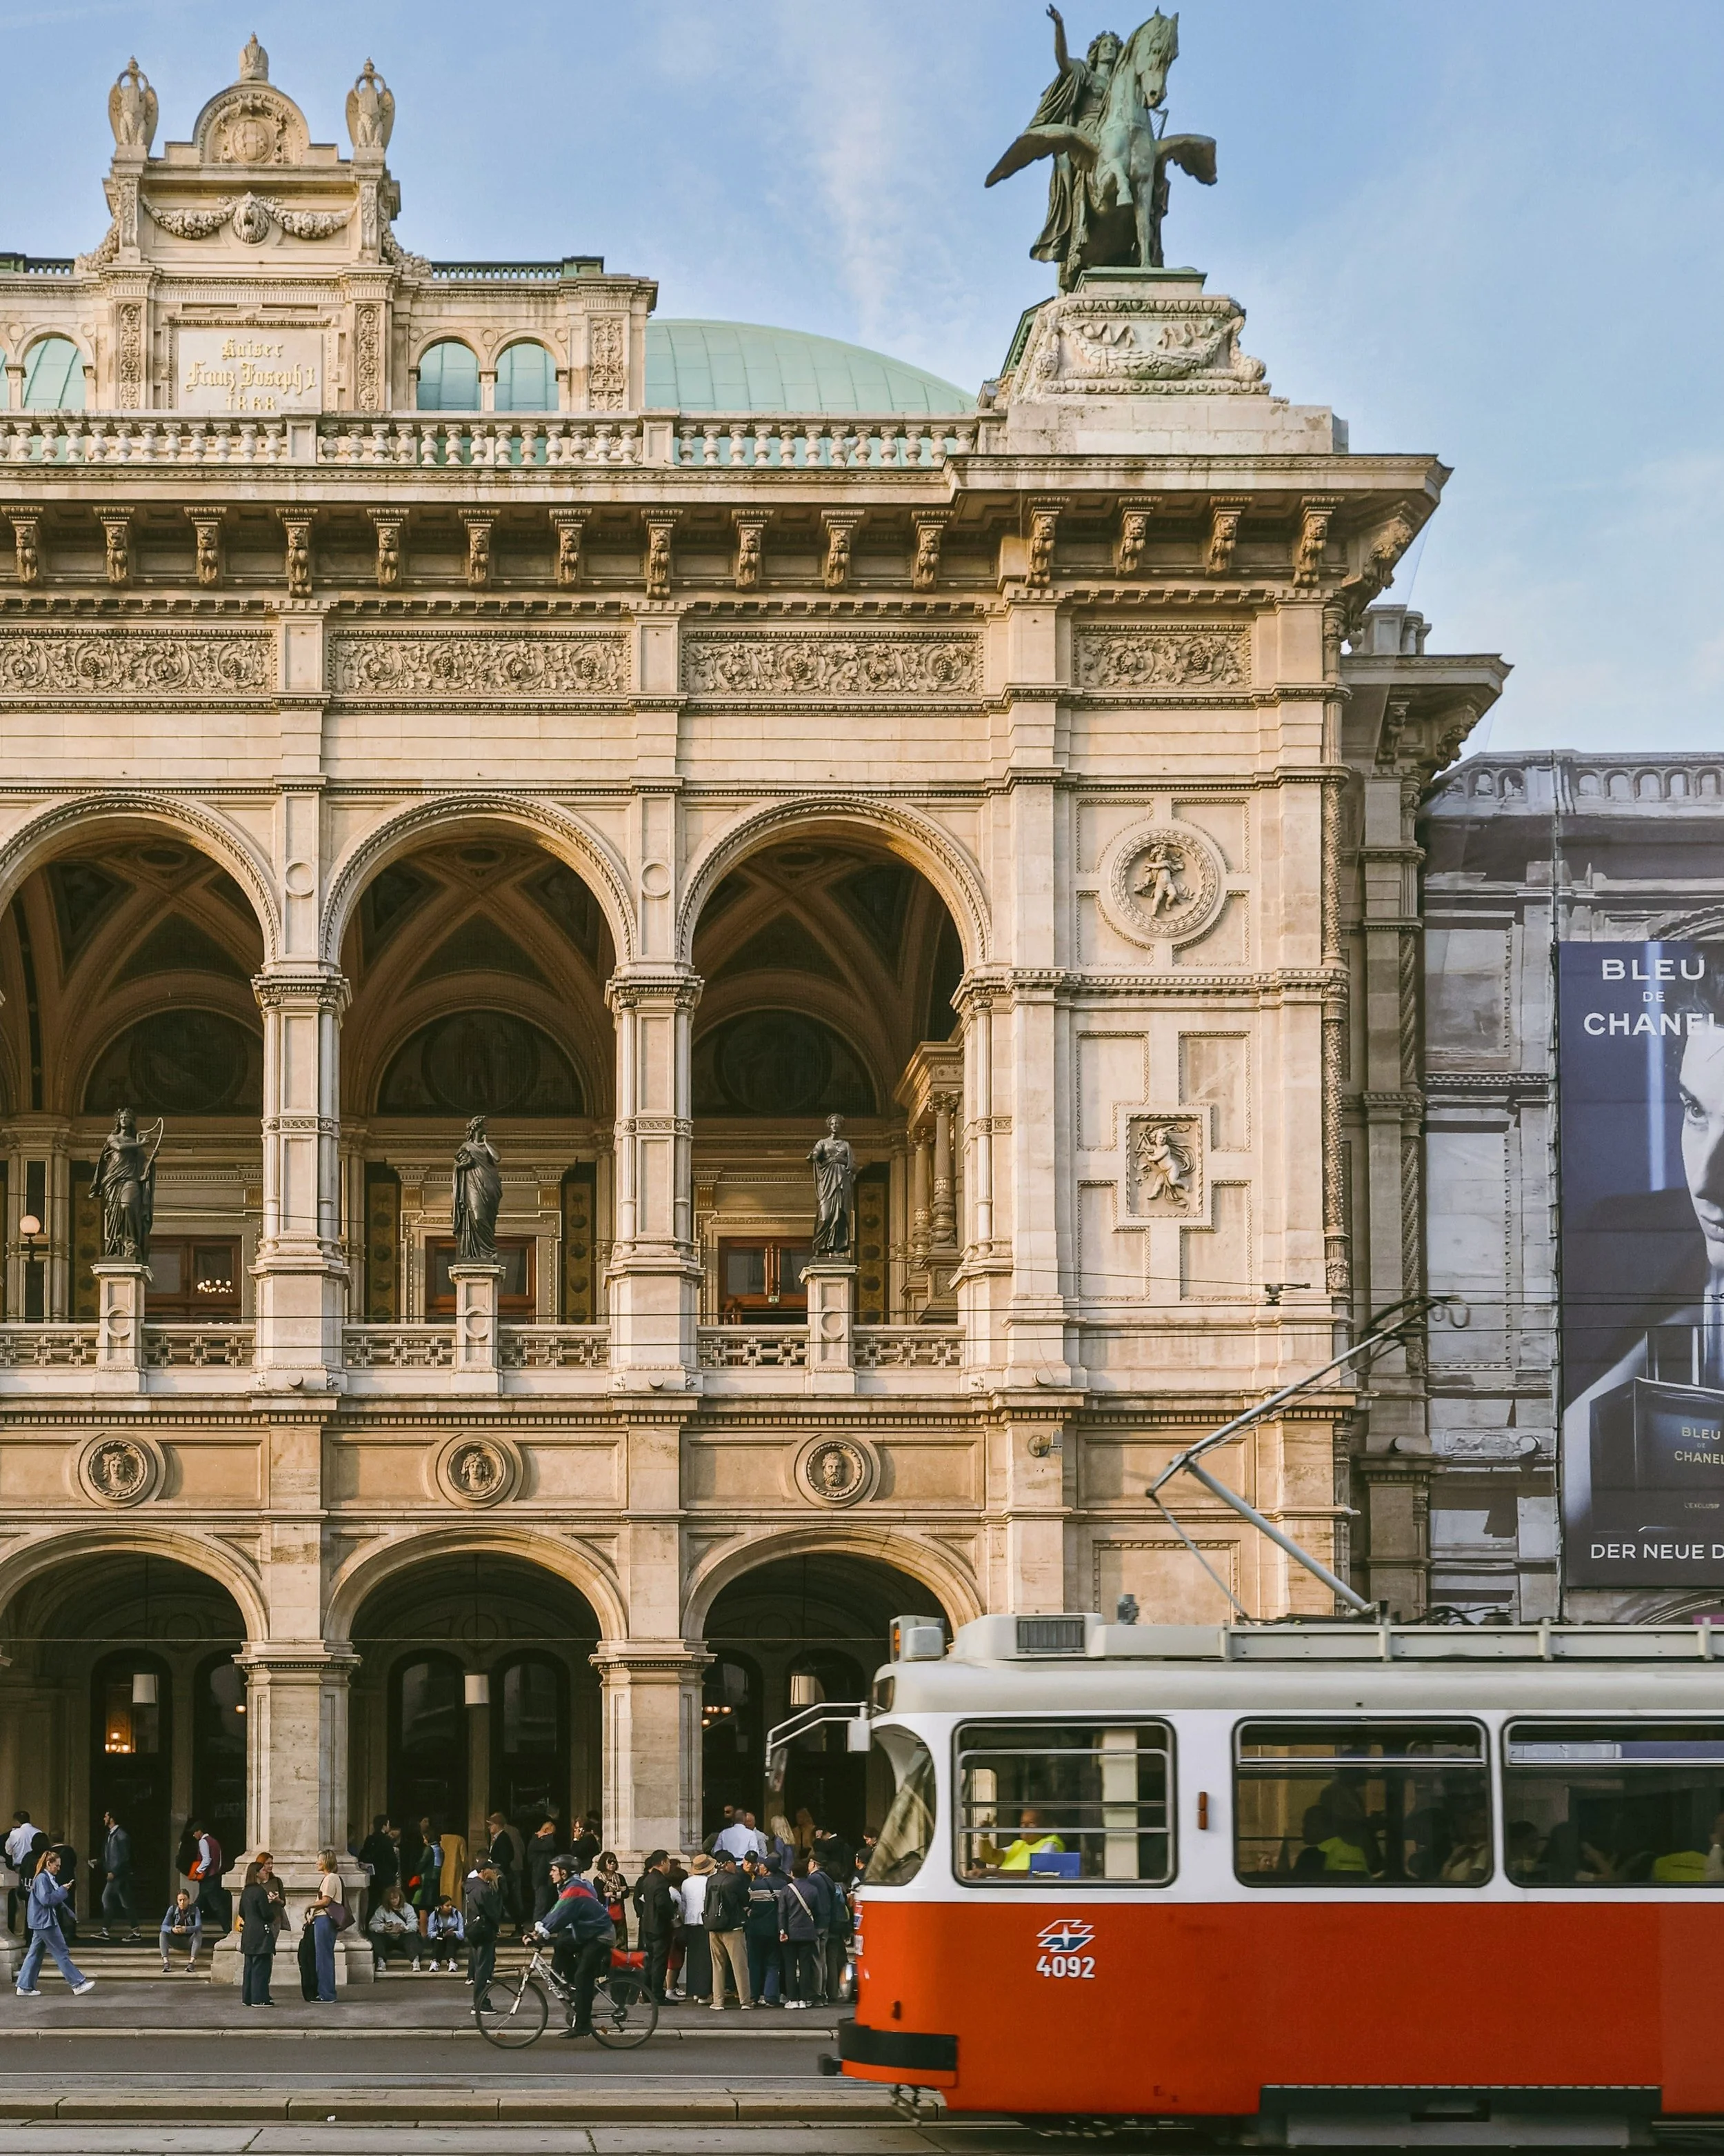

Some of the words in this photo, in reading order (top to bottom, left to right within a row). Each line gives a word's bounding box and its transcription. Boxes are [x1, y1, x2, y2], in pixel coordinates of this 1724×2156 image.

[221, 338, 283, 359] Kaiser
[185, 360, 236, 394] Franz
[240, 362, 303, 395] Joseph
[225, 395, 276, 410] 1868
[1602, 959, 1705, 980] BLEU
[1643, 991, 1665, 1002] DE
[1681, 1426, 1721, 1440] BLEU
[1674, 1450, 1724, 1465] CHANEL
[1590, 1544, 1636, 1559] DER
[1643, 1544, 1705, 1559] NEUE
[1036, 1955, 1096, 1978] 4092
